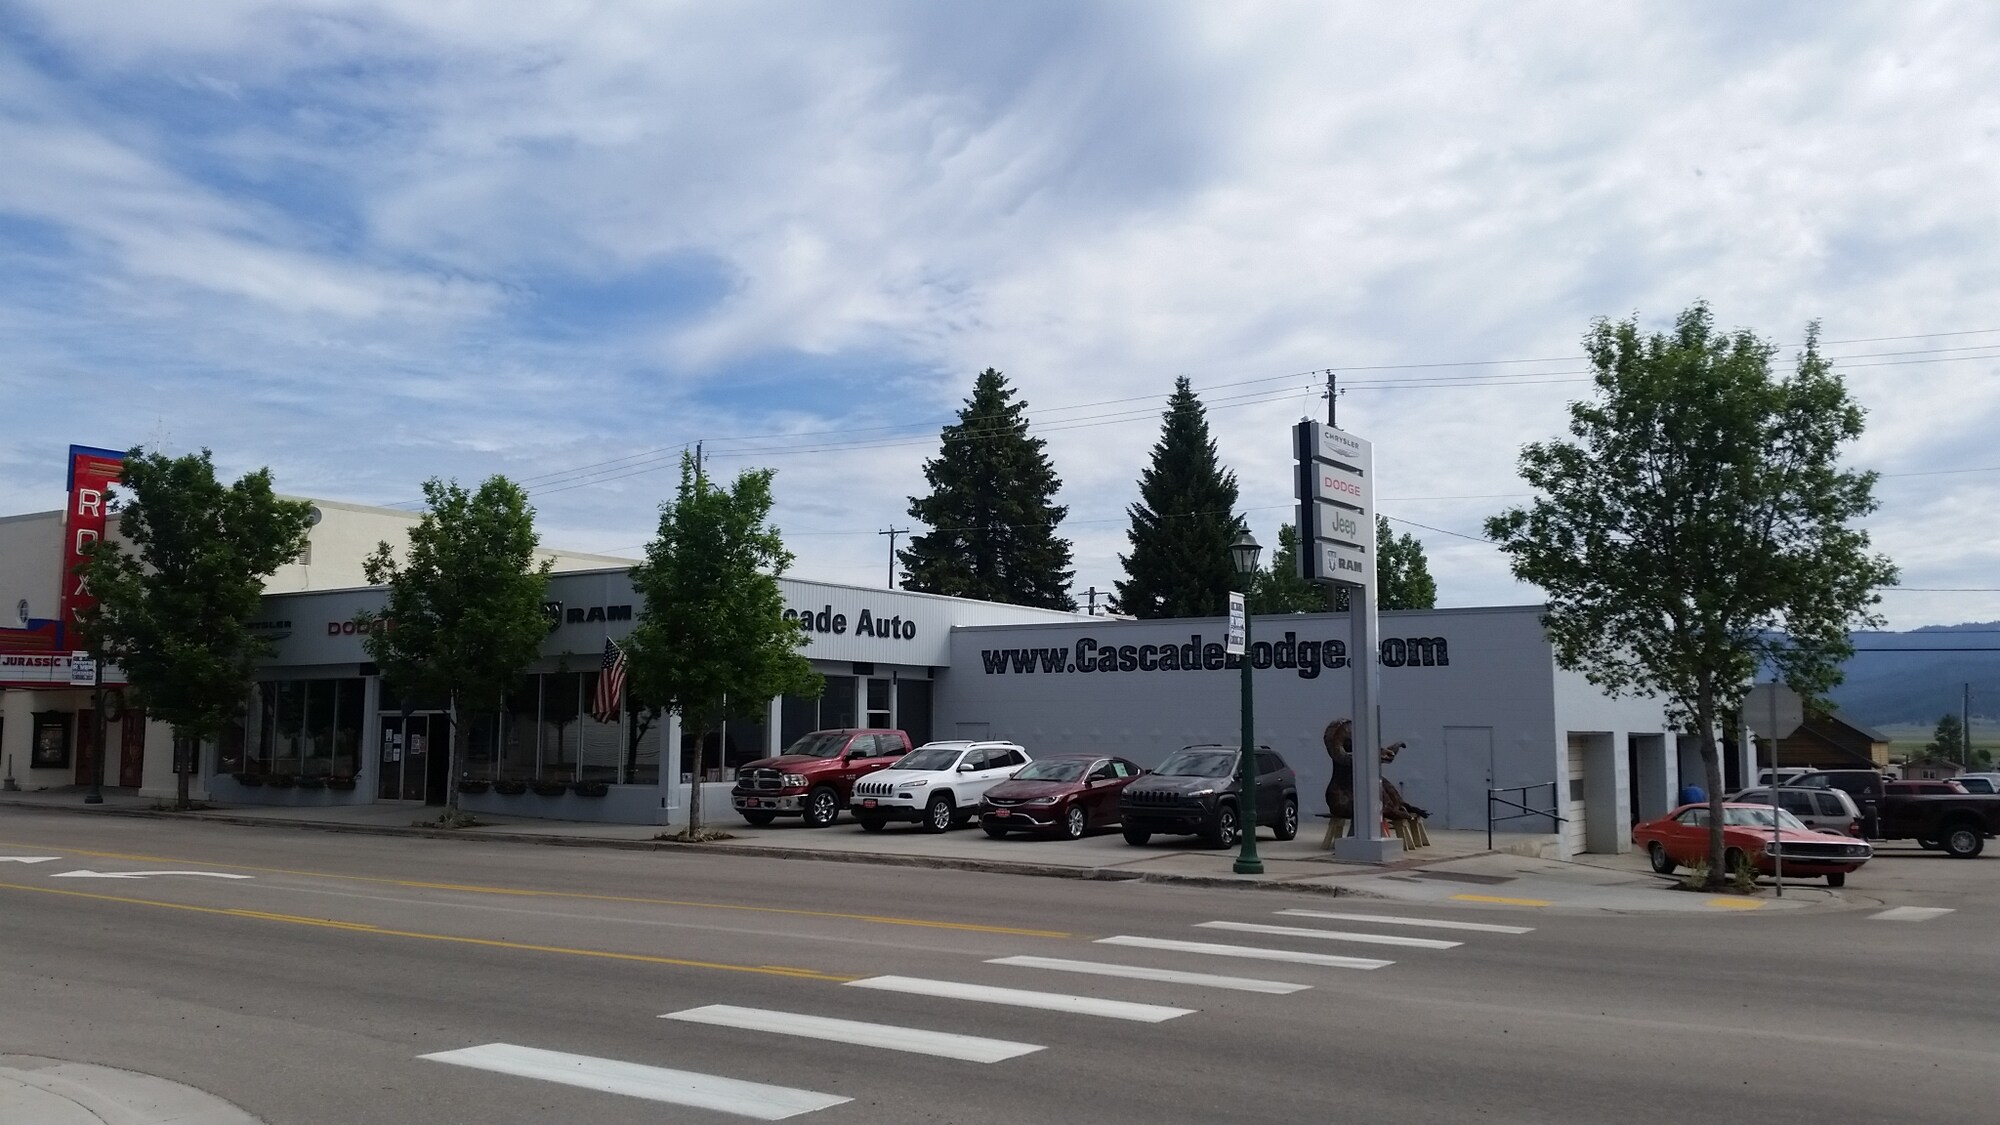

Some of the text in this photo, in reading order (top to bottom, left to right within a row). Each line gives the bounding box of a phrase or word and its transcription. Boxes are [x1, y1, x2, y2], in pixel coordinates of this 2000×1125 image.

[1324, 431, 1360, 449] CHRYSLER
[1324, 476, 1361, 497] DODGE
[1332, 511, 1357, 539] Jeep
[1338, 557, 1363, 573] RAM
[566, 604, 632, 624] RAM
[782, 604, 917, 640] cade Auto
[2, 656, 62, 667] JURASSIC
[981, 631, 1450, 679] www.Cascadeodge.om
